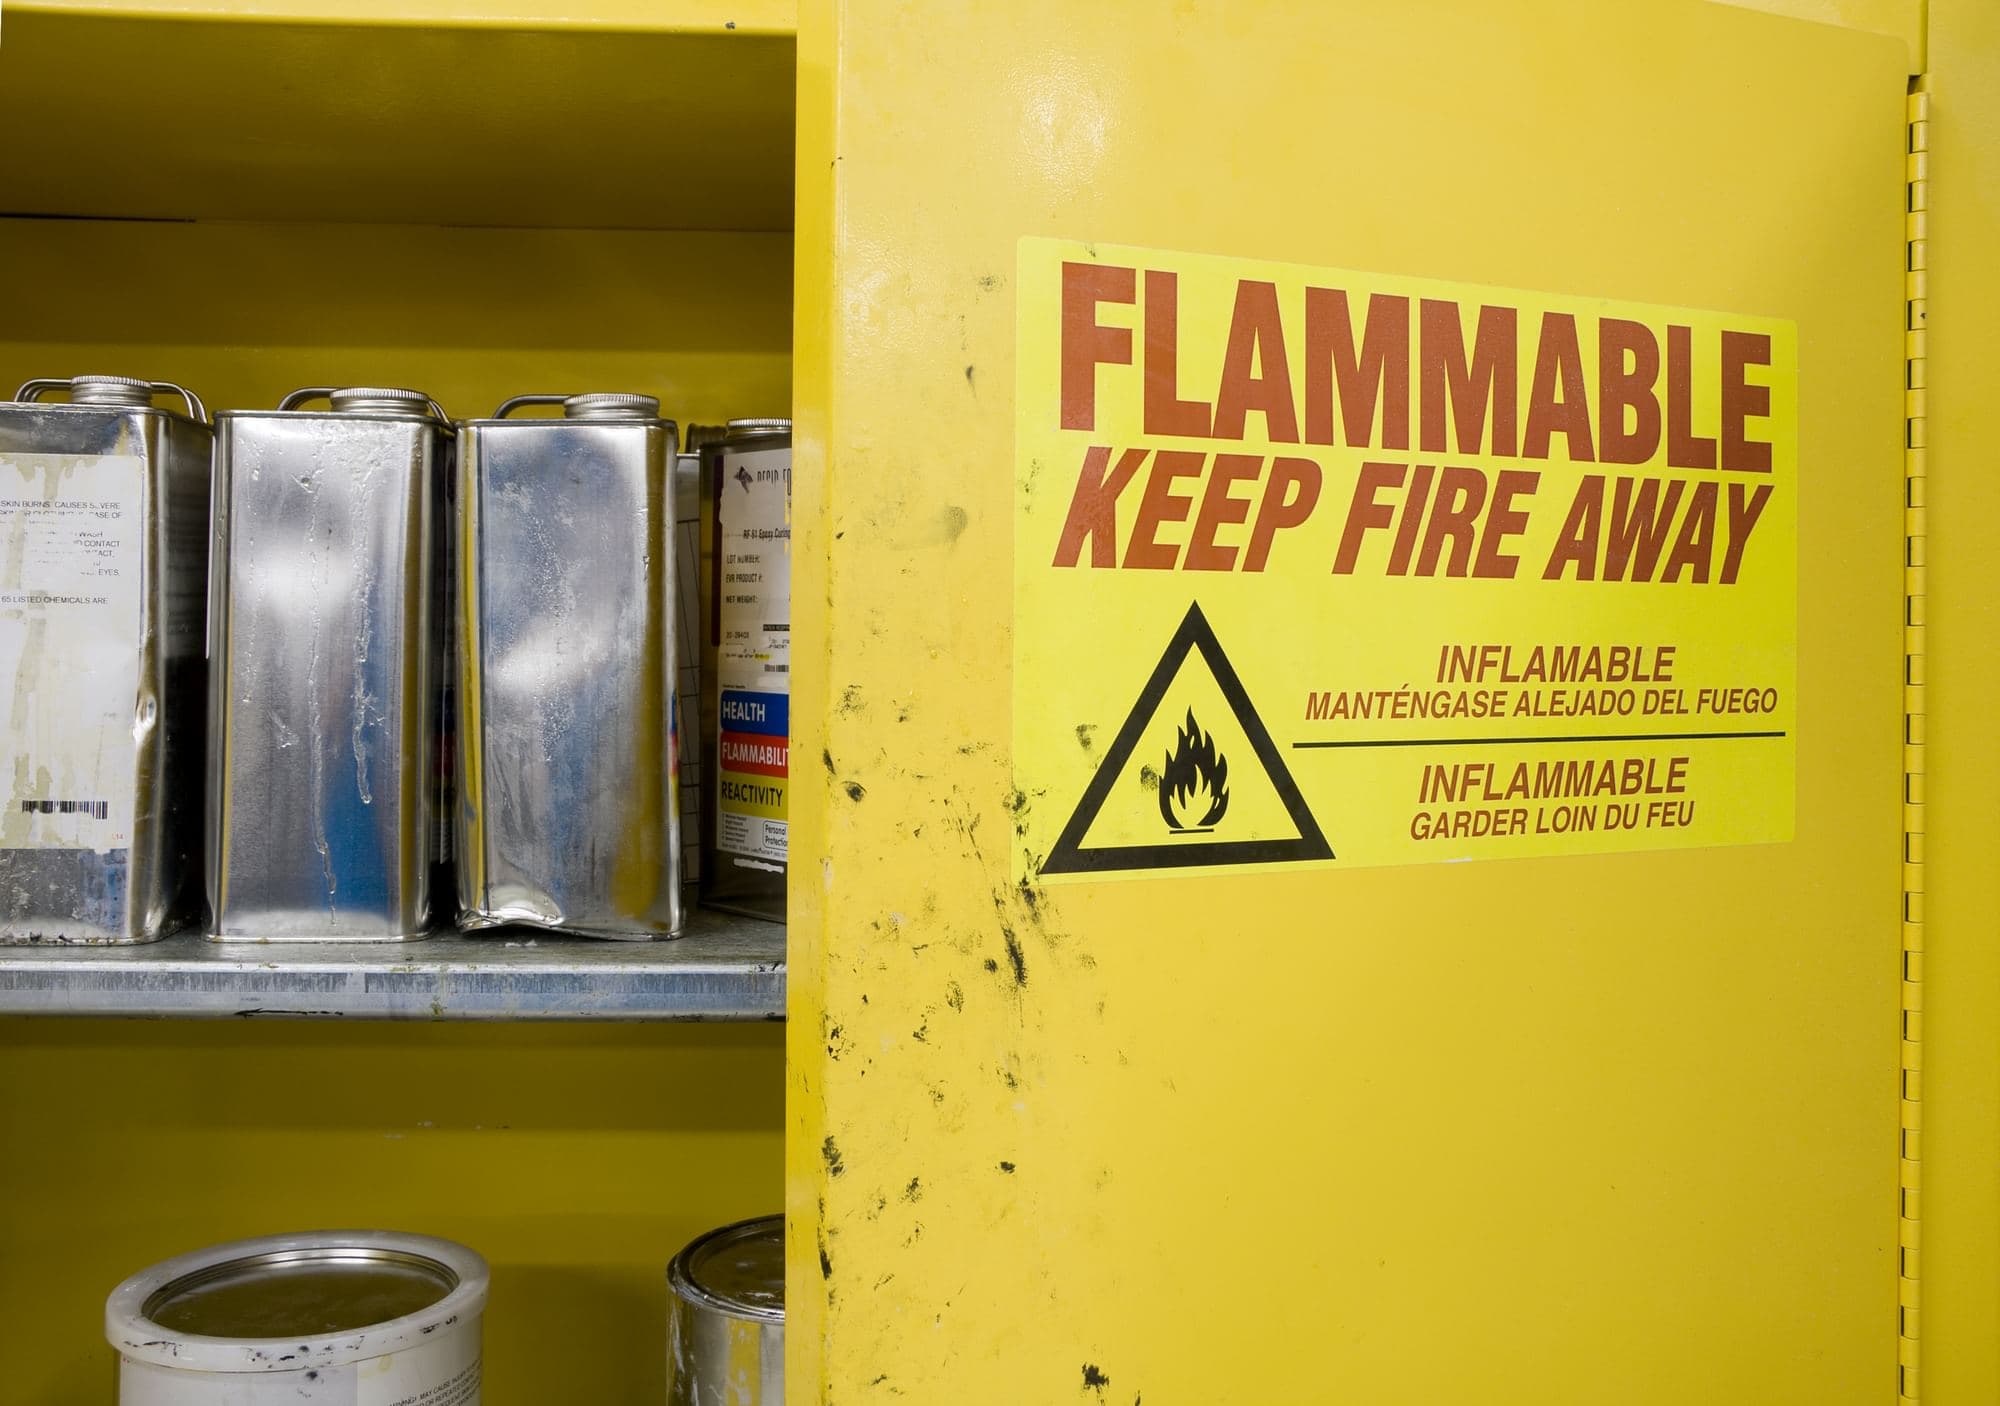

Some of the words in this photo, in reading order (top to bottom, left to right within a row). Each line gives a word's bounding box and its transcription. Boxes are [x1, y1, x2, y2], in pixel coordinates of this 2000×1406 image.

[1060, 261, 1773, 473] FLAMMABLE
[54, 501, 88, 509] CAUSES
[1052, 446, 1322, 572] KEEP
[1332, 462, 1541, 578] FIRE
[1542, 476, 1773, 585] AWAY
[43, 596, 90, 604] CHEMICALS
[1437, 645, 1676, 683] INFLAMABLE
[722, 701, 765, 722] HEALTH
[1305, 684, 1508, 720] MANTÉNGASE
[1513, 689, 1636, 717] ALEJADO
[1642, 689, 1689, 714] DEL
[1696, 687, 1778, 714] FUEGO
[721, 781, 783, 807] REACTIVITY
[1418, 757, 1689, 804] INFLAMMABLE
[1410, 808, 1528, 840] GARDER
[1535, 804, 1597, 833] LOIN
[1603, 802, 1641, 830] DU
[1646, 801, 1695, 827] FEU
